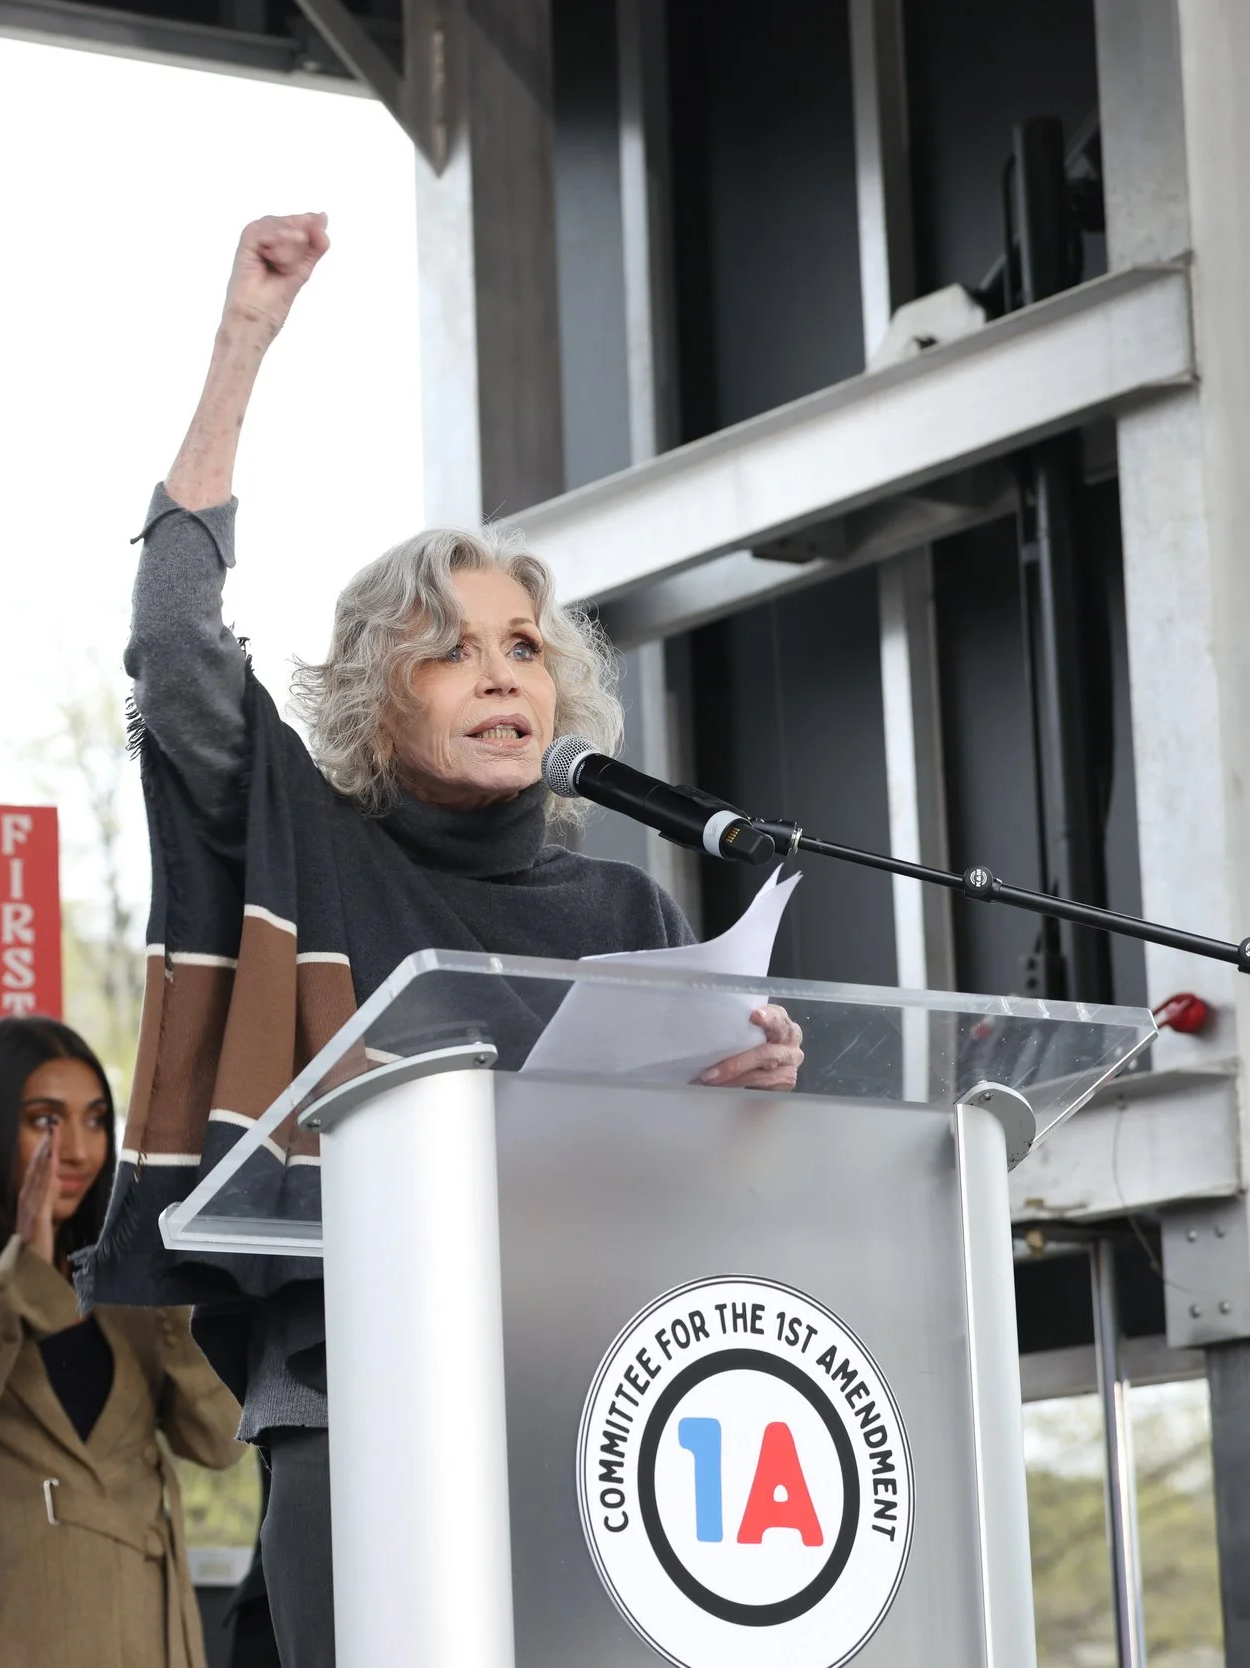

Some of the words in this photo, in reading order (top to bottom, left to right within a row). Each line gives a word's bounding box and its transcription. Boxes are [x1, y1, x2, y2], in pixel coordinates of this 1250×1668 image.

[599, 1347, 661, 1533] COMMITTEE
[655, 1310, 710, 1360] FOR
[715, 1302, 765, 1335] THE
[776, 1311, 818, 1353] 1ST
[816, 1345, 898, 1542] AMENDMENT
[678, 1417, 824, 1547] 1A
